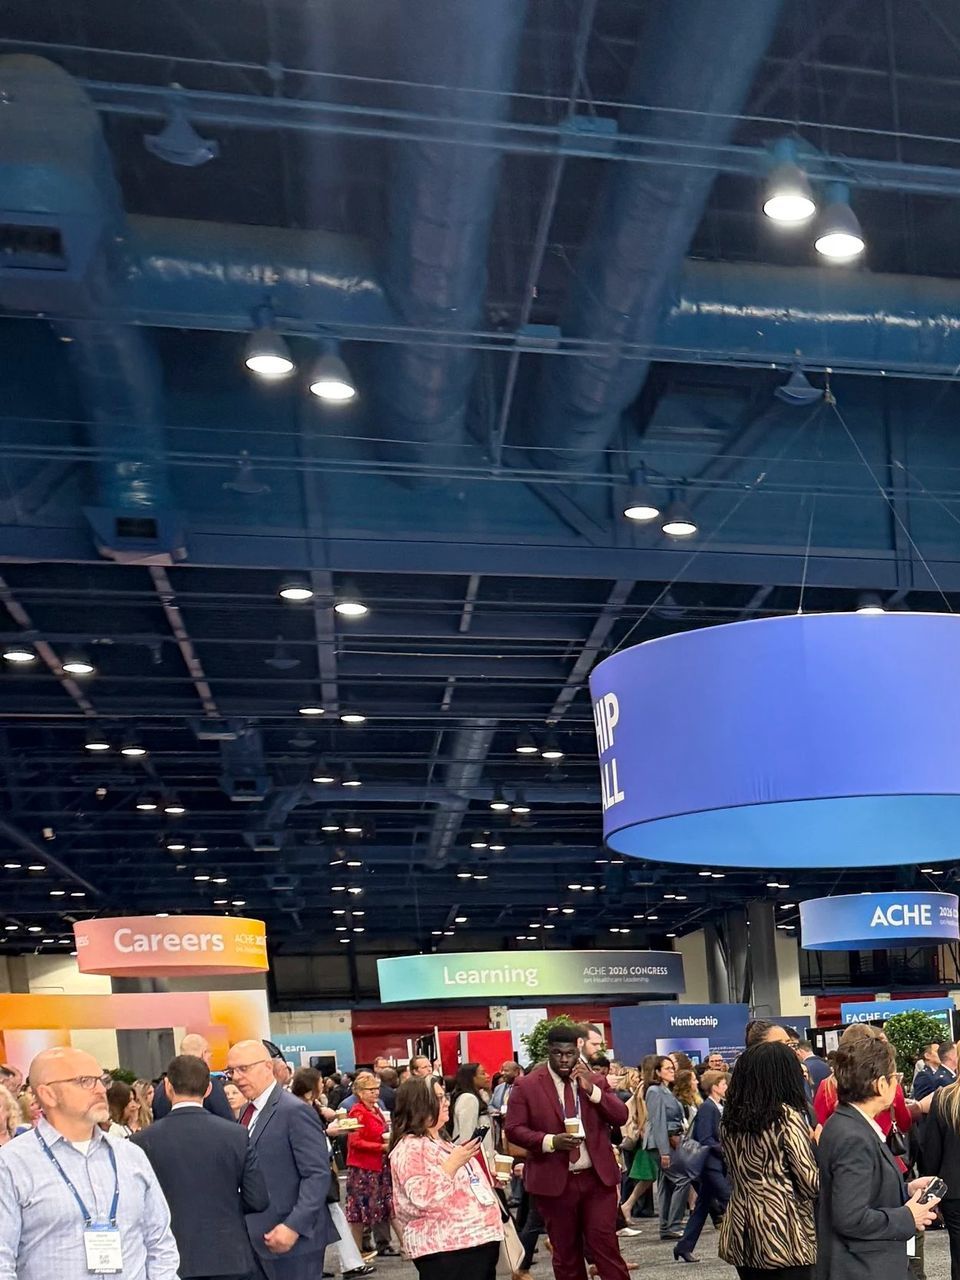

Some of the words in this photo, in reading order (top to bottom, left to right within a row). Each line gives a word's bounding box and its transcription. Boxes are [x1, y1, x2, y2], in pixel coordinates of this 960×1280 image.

[870, 904, 932, 927] ACHE
[113, 927, 225, 953] Careers
[443, 964, 539, 987] Learning
[583, 966, 607, 976] ACHE
[608, 966, 628, 975] 2026
[629, 966, 668, 975] CONGRESS
[670, 1015, 718, 1027] Membership
[280, 1044, 307, 1053] Learn
